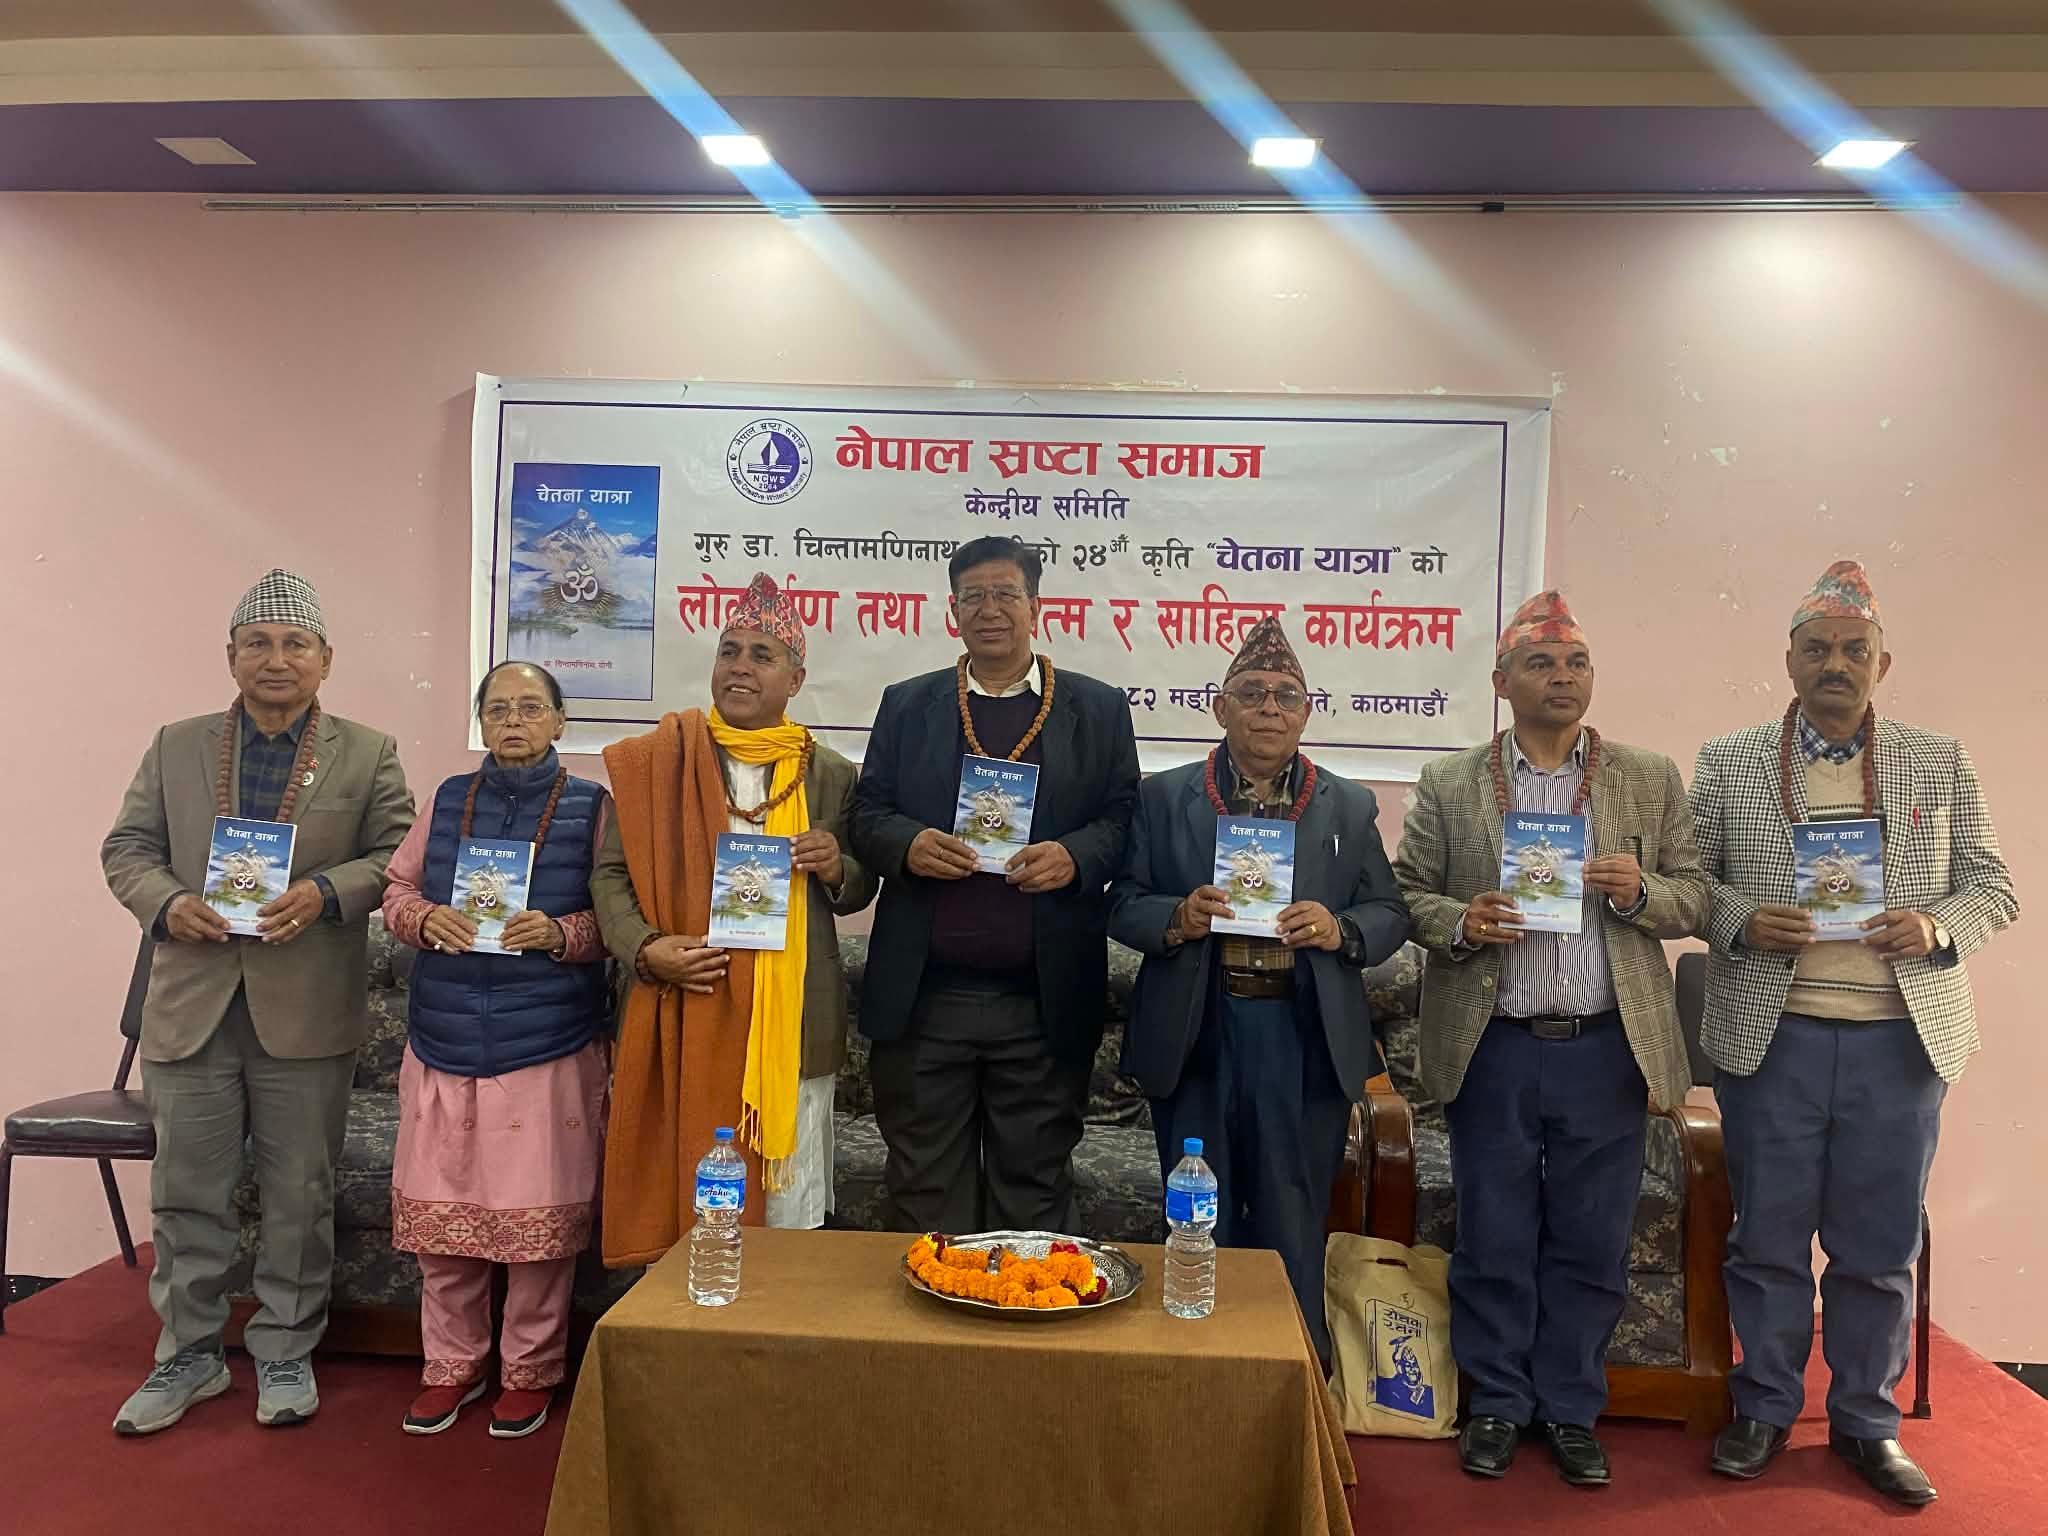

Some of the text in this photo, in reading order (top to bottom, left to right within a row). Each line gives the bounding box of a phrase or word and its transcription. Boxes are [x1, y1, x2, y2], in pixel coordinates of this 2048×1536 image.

[834, 425, 1266, 479] नेपाल स्रष्टा समाज
[753, 474, 786, 484] NCWS
[536, 484, 632, 505] चेतना यात्रा
[964, 487, 1130, 520] केन्द्रीय समिति
[694, 531, 731, 563] गुरु
[743, 534, 779, 558] डा.
[1141, 537, 1194, 577] कृति
[1410, 545, 1449, 575] को
[856, 591, 929, 638] तथा
[1109, 599, 1140, 653] र
[1303, 589, 1462, 652] कार्यक्रम
[1350, 688, 1448, 717] काठमाडौं
[973, 765, 999, 779] चेतना
[1229, 824, 1256, 837] चेतना
[1516, 819, 1545, 832] चेतना
[225, 826, 253, 840] चेतना
[1806, 831, 1836, 841] चेतना
[469, 845, 493, 857] चेतना
[729, 840, 754, 852] चेतना
